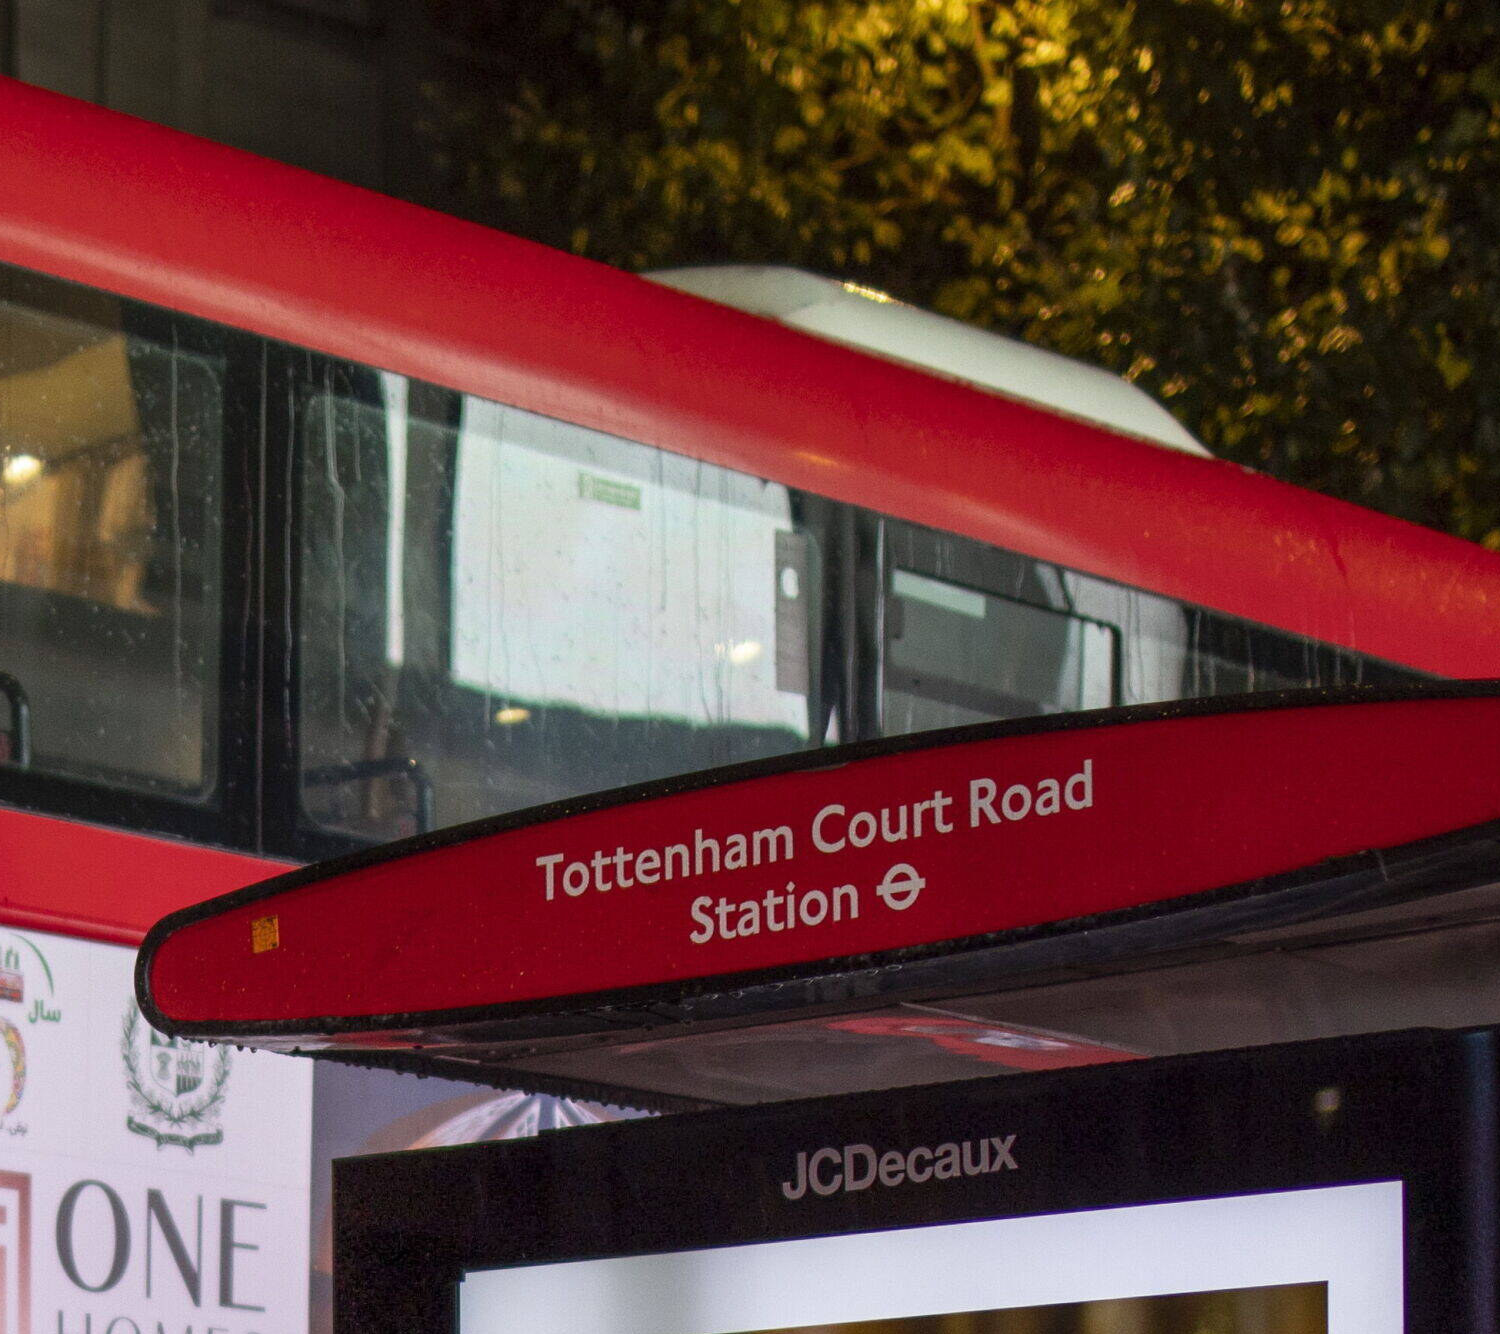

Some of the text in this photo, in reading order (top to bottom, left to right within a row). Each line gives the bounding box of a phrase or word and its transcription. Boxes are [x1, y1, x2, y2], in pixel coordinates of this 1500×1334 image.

[536, 758, 1095, 902] Tottenham Court Road
[690, 880, 859, 945] Station
[782, 1133, 1020, 1201] JCDecaux
[54, 1178, 267, 1313] ONE
